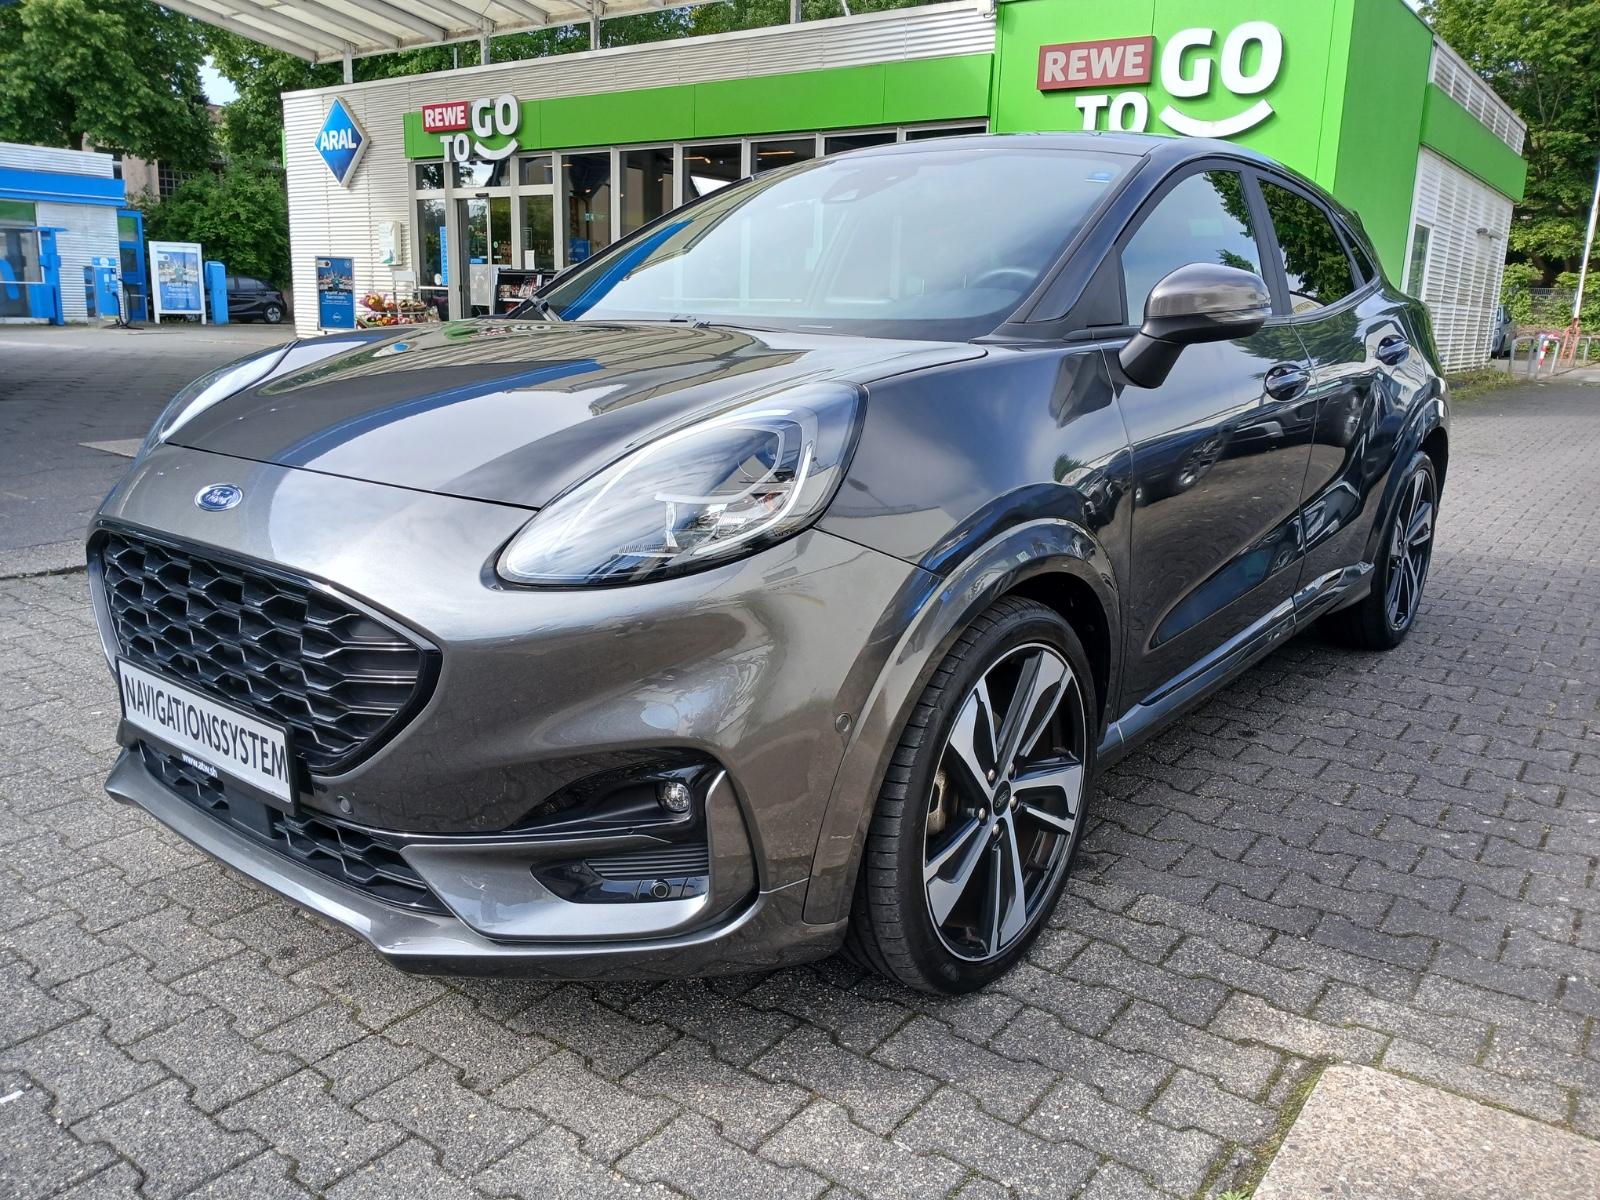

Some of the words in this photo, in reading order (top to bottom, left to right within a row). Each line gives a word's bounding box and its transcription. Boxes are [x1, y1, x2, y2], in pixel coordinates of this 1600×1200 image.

[1043, 44, 1145, 83] REWE
[1075, 91, 1149, 132] TO
[1160, 20, 1283, 97] GO
[320, 127, 357, 151] ARAL
[424, 105, 466, 128] REWE
[439, 132, 470, 162] TO
[471, 94, 519, 138] GO
[124, 674, 290, 784] NAVIGATIONSSYSTEM
